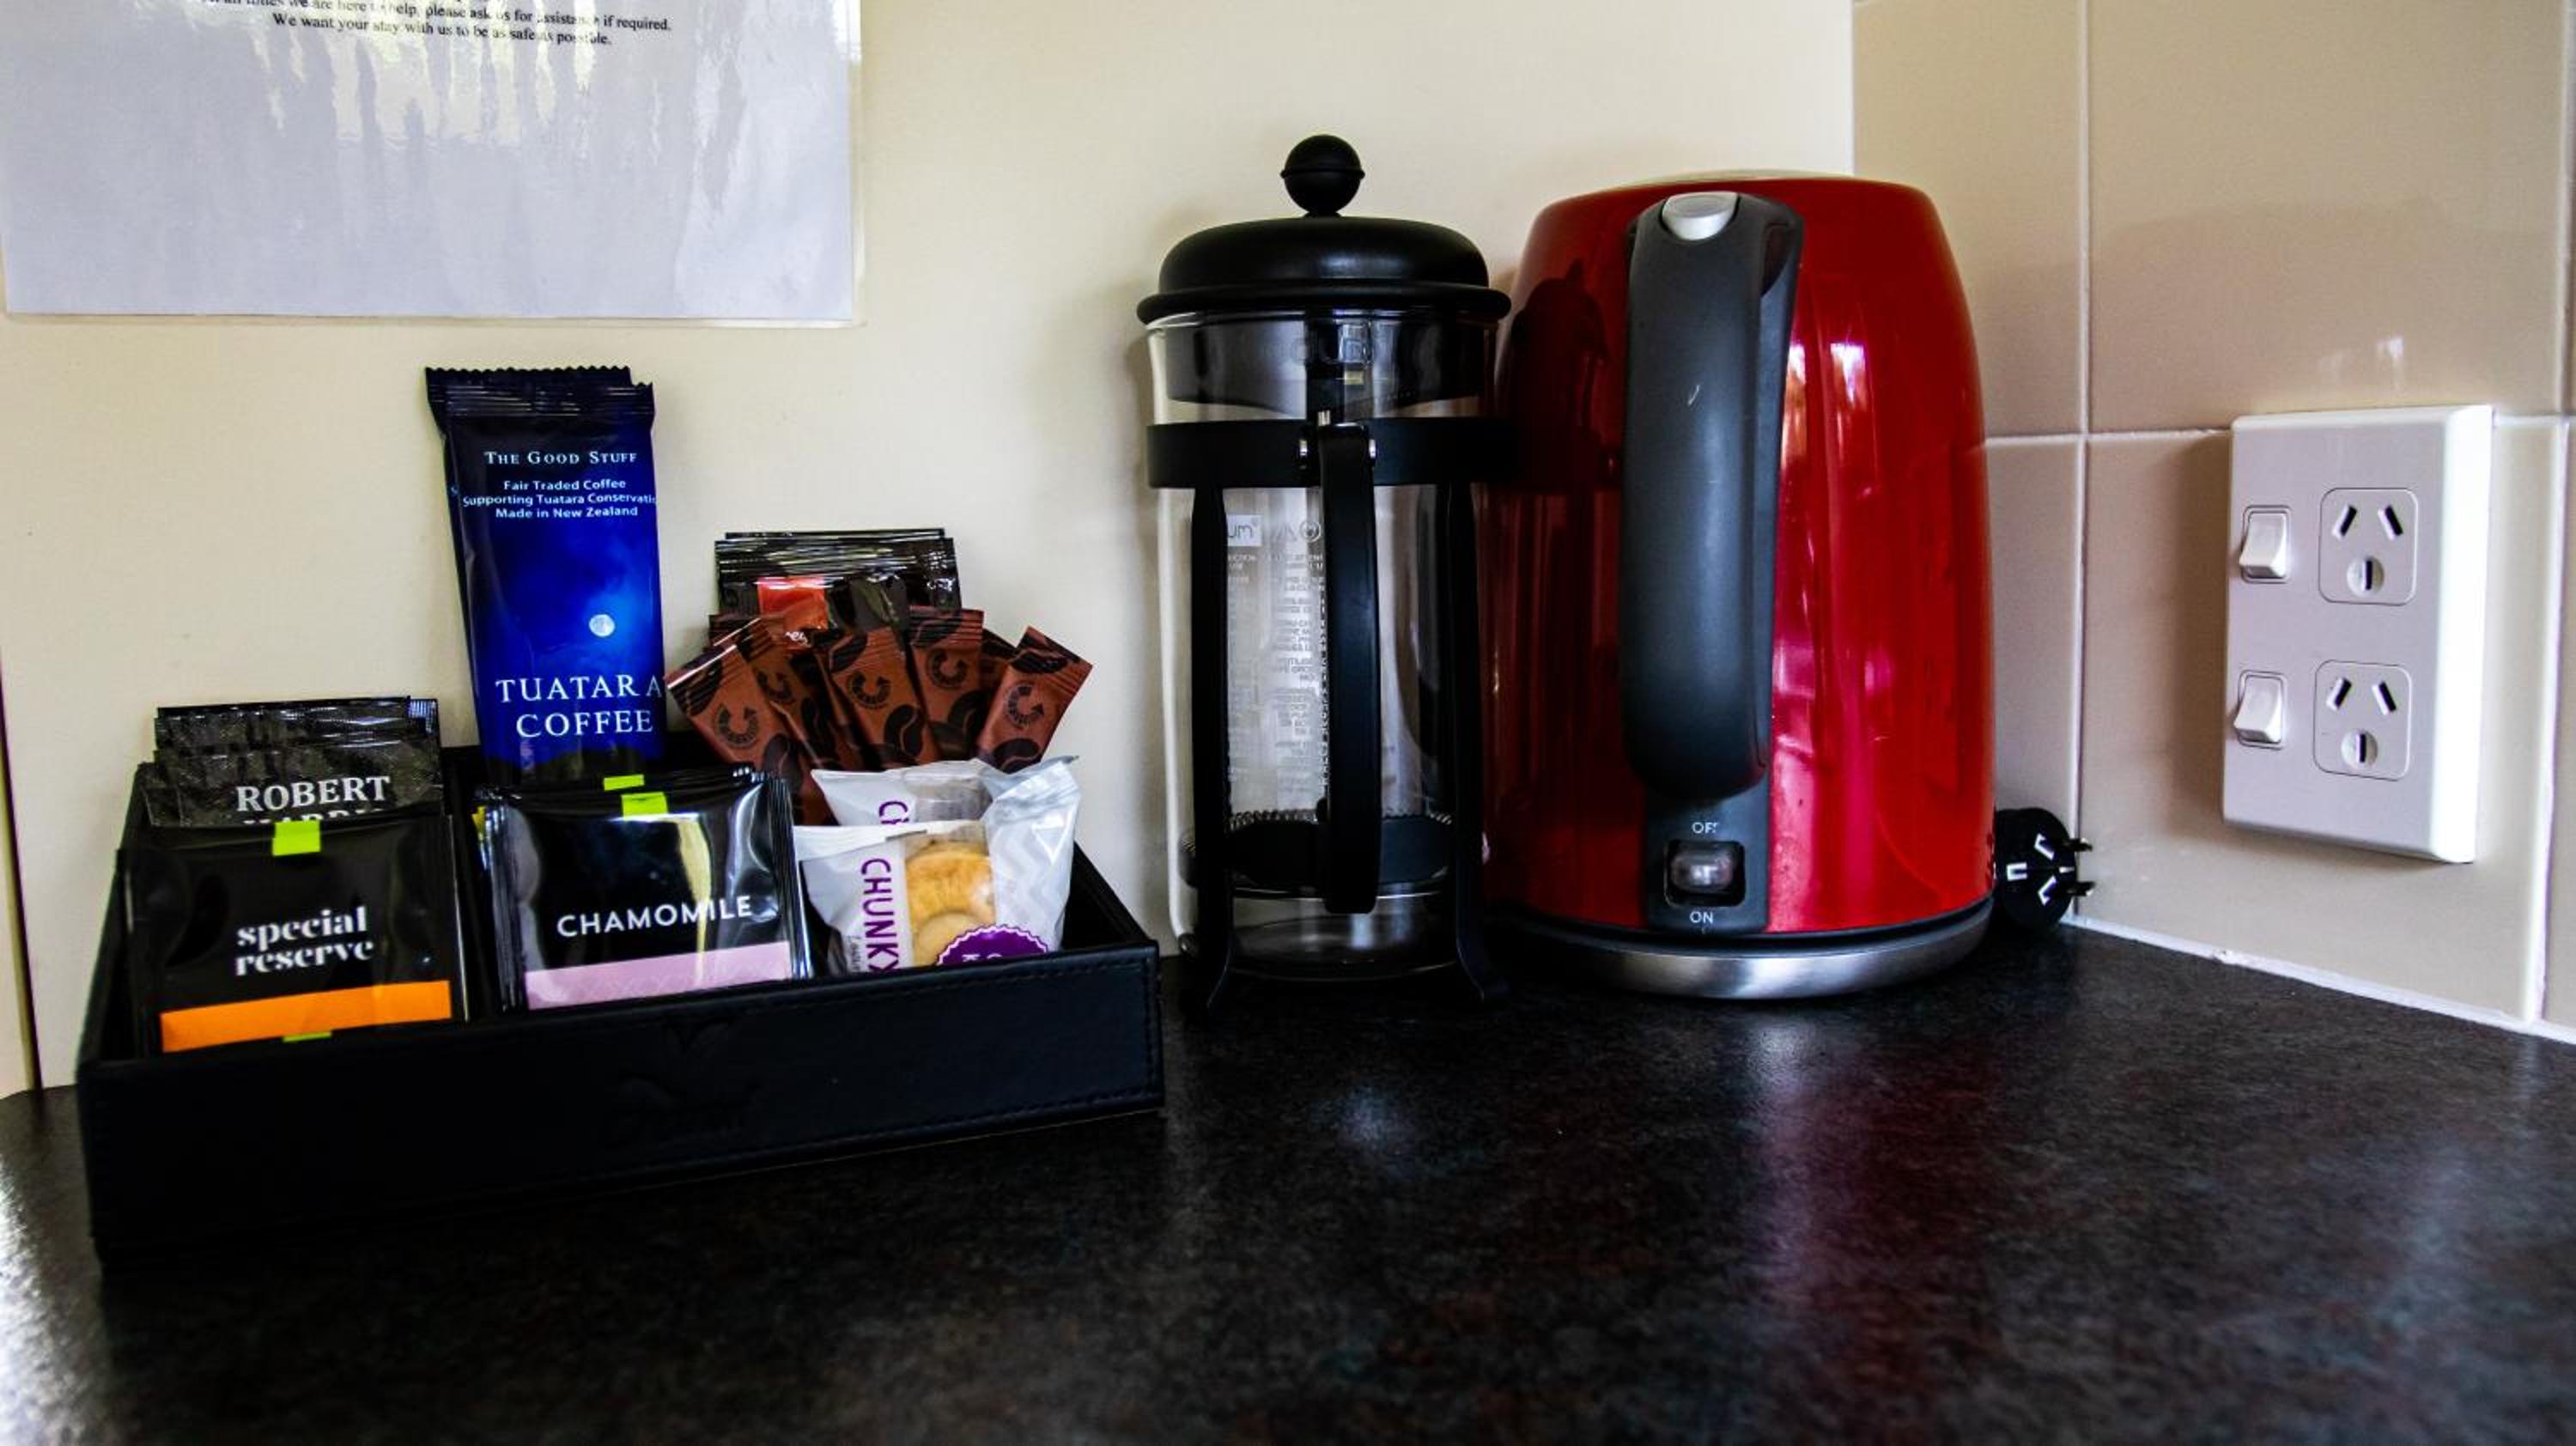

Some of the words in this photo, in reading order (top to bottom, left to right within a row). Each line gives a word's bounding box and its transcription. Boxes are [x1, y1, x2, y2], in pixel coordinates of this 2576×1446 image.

[273, 12, 296, 26] We
[301, 16, 333, 28] want
[337, 20, 368, 32] your
[404, 23, 433, 35] with
[438, 26, 453, 36] us
[473, 25, 488, 38] be
[510, 27, 535, 40] safe
[426, 4, 465, 21] please
[470, 9, 492, 20] ask
[515, 9, 532, 21] for
[604, 15, 614, 27] if
[617, 16, 672, 32] required.
[484, 451, 519, 465] THE
[527, 451, 580, 465] GOOD
[589, 451, 637, 465] STUFF
[503, 480, 529, 490] Fair
[532, 479, 580, 490] Traded
[583, 478, 626, 490] Coffee
[463, 494, 533, 507] Supporting
[536, 493, 585, 505] Tuatara
[495, 507, 532, 518] Made
[537, 507, 549, 518] in
[552, 507, 582, 518] New
[586, 506, 638, 517] Zealand
[495, 674, 663, 702] TUATARA
[516, 710, 653, 738] COFFEE
[235, 775, 391, 811] ROBERT
[237, 905, 367, 951] special
[556, 896, 751, 938] CHAMOMILE
[1689, 911, 1714, 924] ON
[235, 940, 374, 976] reserve
